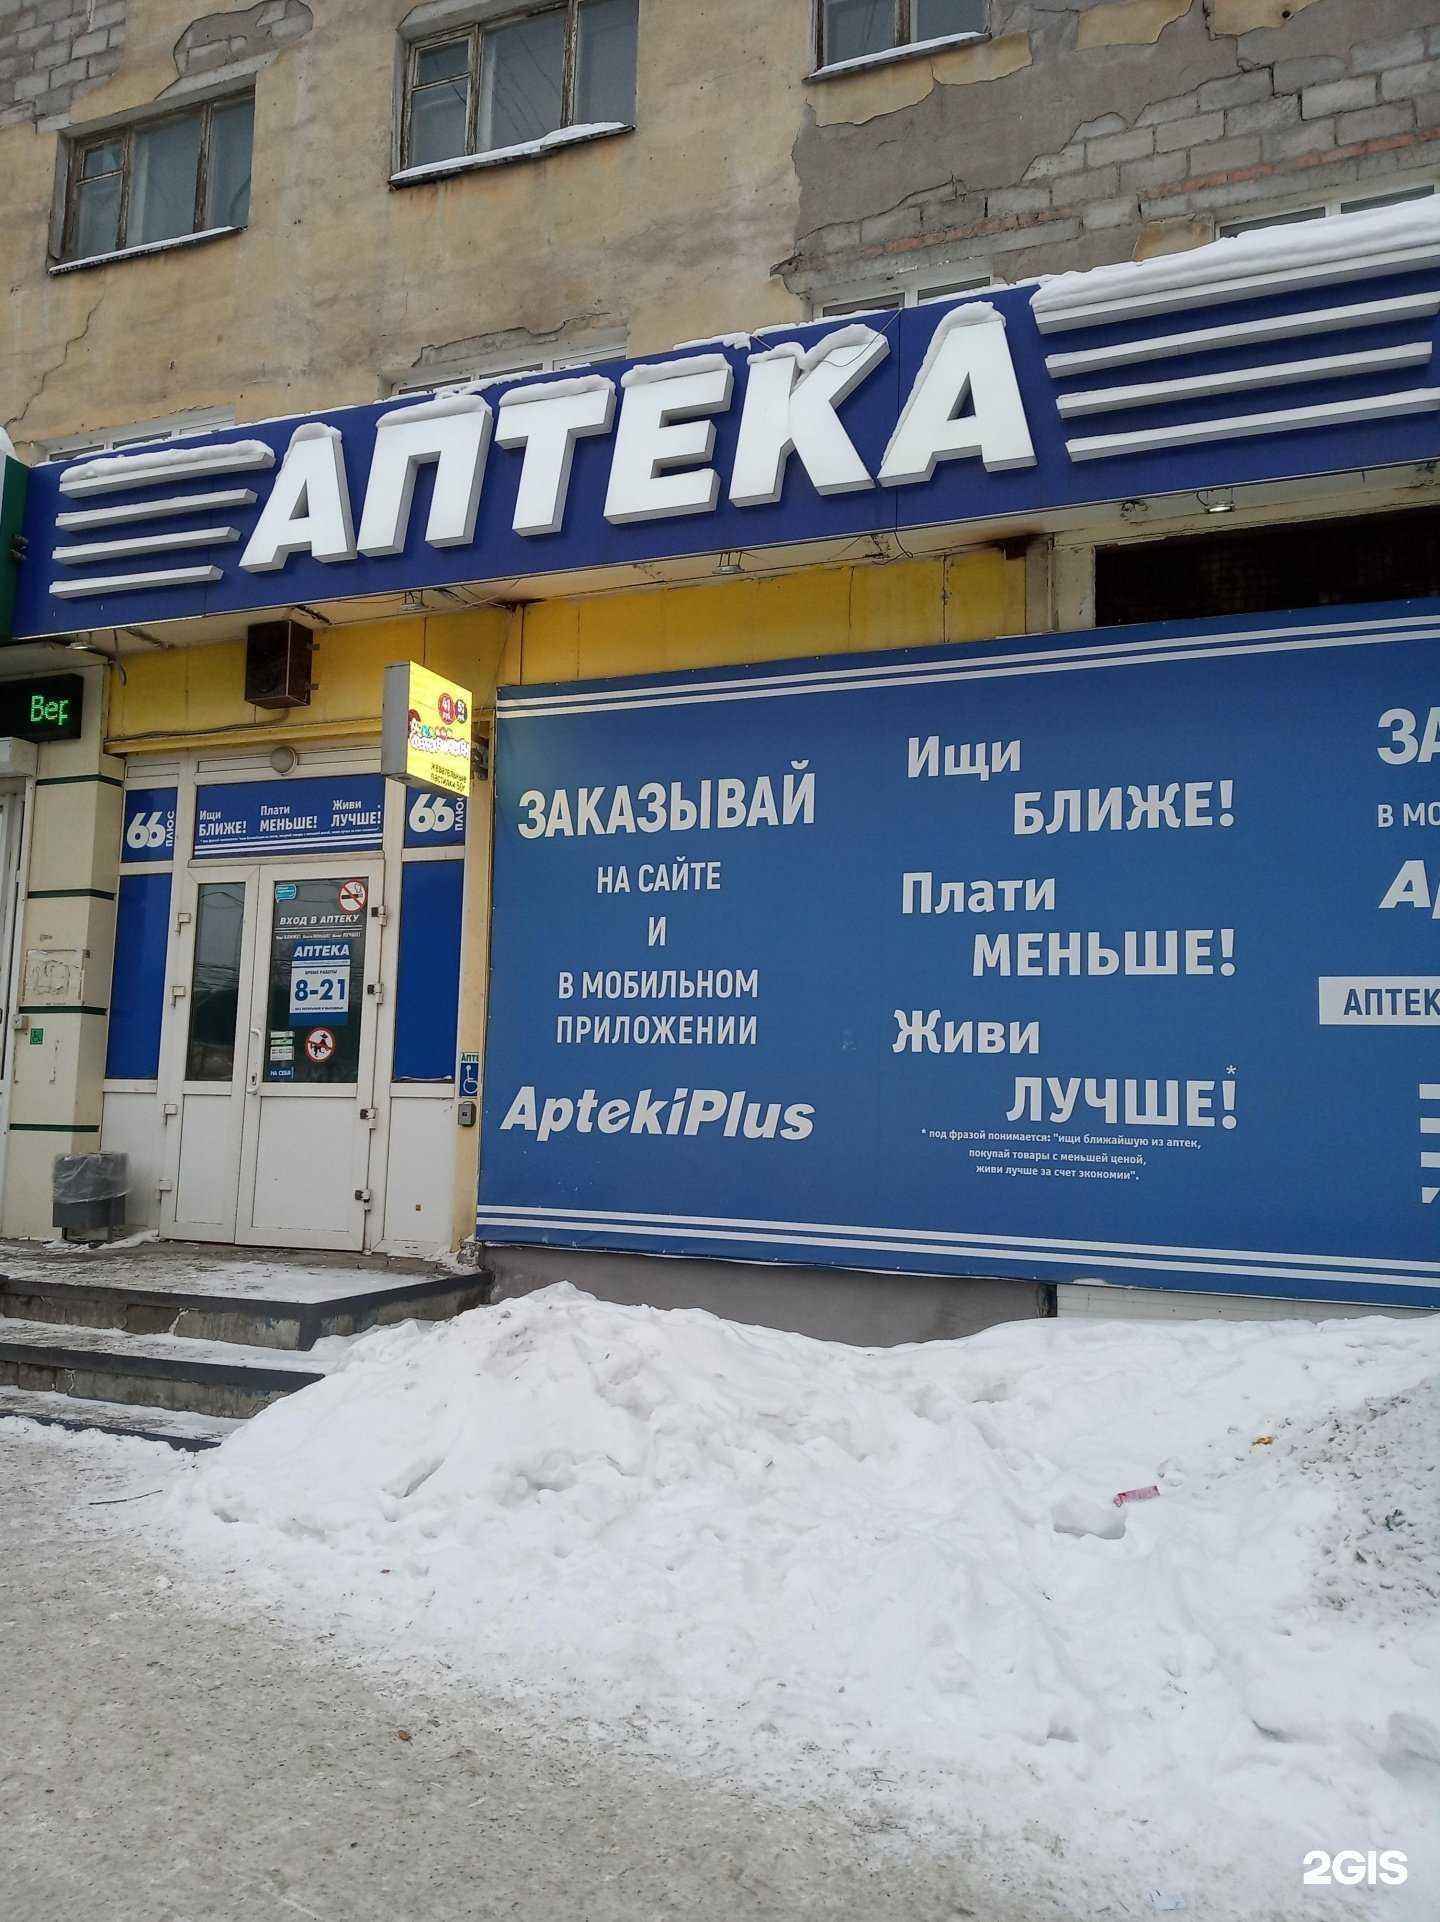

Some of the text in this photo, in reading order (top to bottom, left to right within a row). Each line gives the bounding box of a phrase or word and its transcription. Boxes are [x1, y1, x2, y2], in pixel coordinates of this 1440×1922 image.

[239, 312, 1036, 573] АПТЕКА
[908, 735, 1021, 781] Ищи
[260, 805, 290, 816] Плати
[332, 799, 362, 811] Живи
[409, 793, 455, 833] 66
[518, 759, 816, 839] ЗАКАЗЫВАЙ
[1013, 779, 1234, 835] БЛИЖЕ!
[127, 811, 166, 849] 66
[199, 810, 221, 820] Ищи
[199, 820, 247, 837] БЛИЖЕ!
[259, 815, 318, 833] МЕНЬШЕ!
[330, 811, 381, 828] ЛУЧШЕ!
[1377, 804, 1394, 828] В
[597, 855, 721, 894] НА САЙТЕ
[1378, 859, 1440, 920] A
[902, 871, 1055, 914] Плати
[280, 914, 360, 925] ВХОД В АПТЕКУ
[648, 916, 667, 947] И
[293, 944, 350, 958] АПТЕКА
[972, 928, 1236, 977] МЕНЬШЕ!
[294, 978, 346, 1001] 8-21
[558, 968, 759, 999] В МОБИЛЬНОМ
[1343, 989, 1440, 1016] АПТЕК
[556, 1015, 757, 1045] ПРИЛОЖЕНИИ
[891, 1009, 1040, 1054] Живи
[499, 1086, 816, 1142] AptekiPlus
[1005, 1075, 1237, 1130] ЛУЧШЕ!
[929, 1130, 947, 1139] под
[948, 1129, 986, 1141] фразой
[988, 1132, 1051, 1141] понимается:
[1083, 1134, 1149, 1147] ближайшую
[1151, 1138, 1164, 1146] из
[1166, 1139, 1201, 1149] аптек,
[969, 1149, 1010, 1159] покупай
[1012, 1152, 1050, 1161] товары
[1060, 1153, 1108, 1163] меньшей
[1110, 1155, 1147, 1166] ценой,
[976, 1165, 1003, 1173] живи
[1005, 1167, 1038, 1176] лучше
[1054, 1169, 1077, 1177] счет
